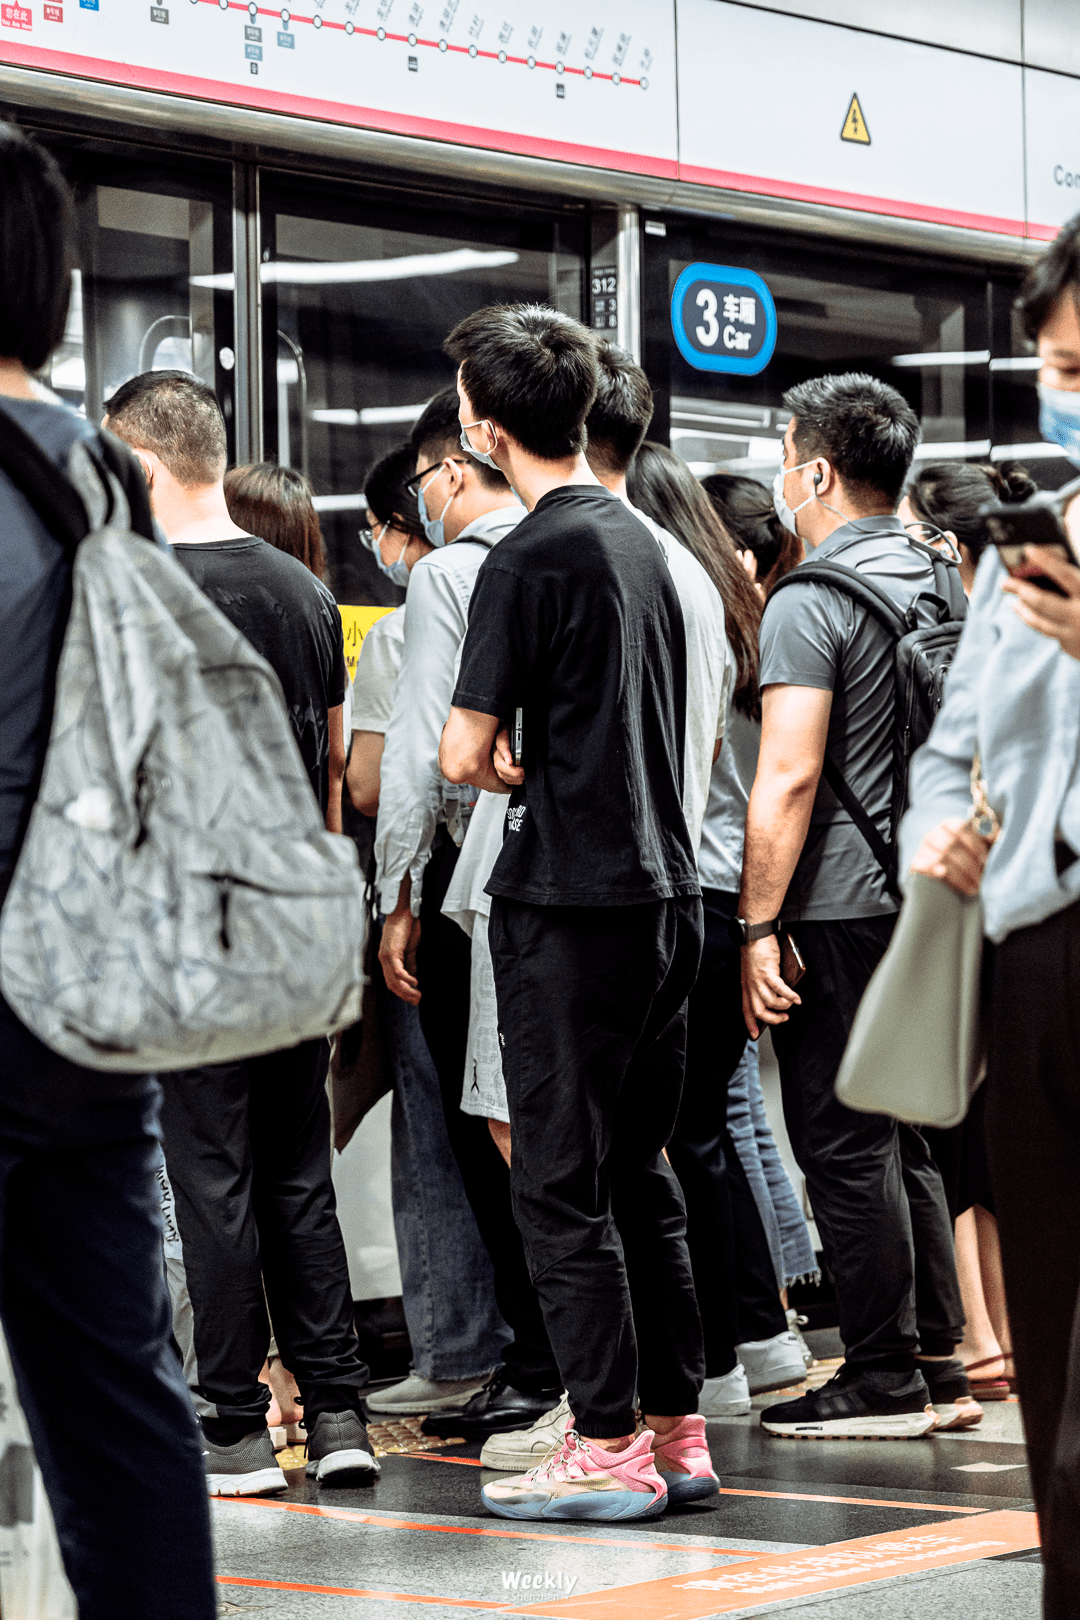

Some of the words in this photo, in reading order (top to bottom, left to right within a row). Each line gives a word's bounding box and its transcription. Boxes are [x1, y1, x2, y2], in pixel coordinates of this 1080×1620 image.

[6, 8, 28, 21] 您在此
[592, 276, 616, 294] 312
[695, 288, 719, 347] 3
[722, 293, 756, 326] 车厢
[723, 324, 752, 351] Car
